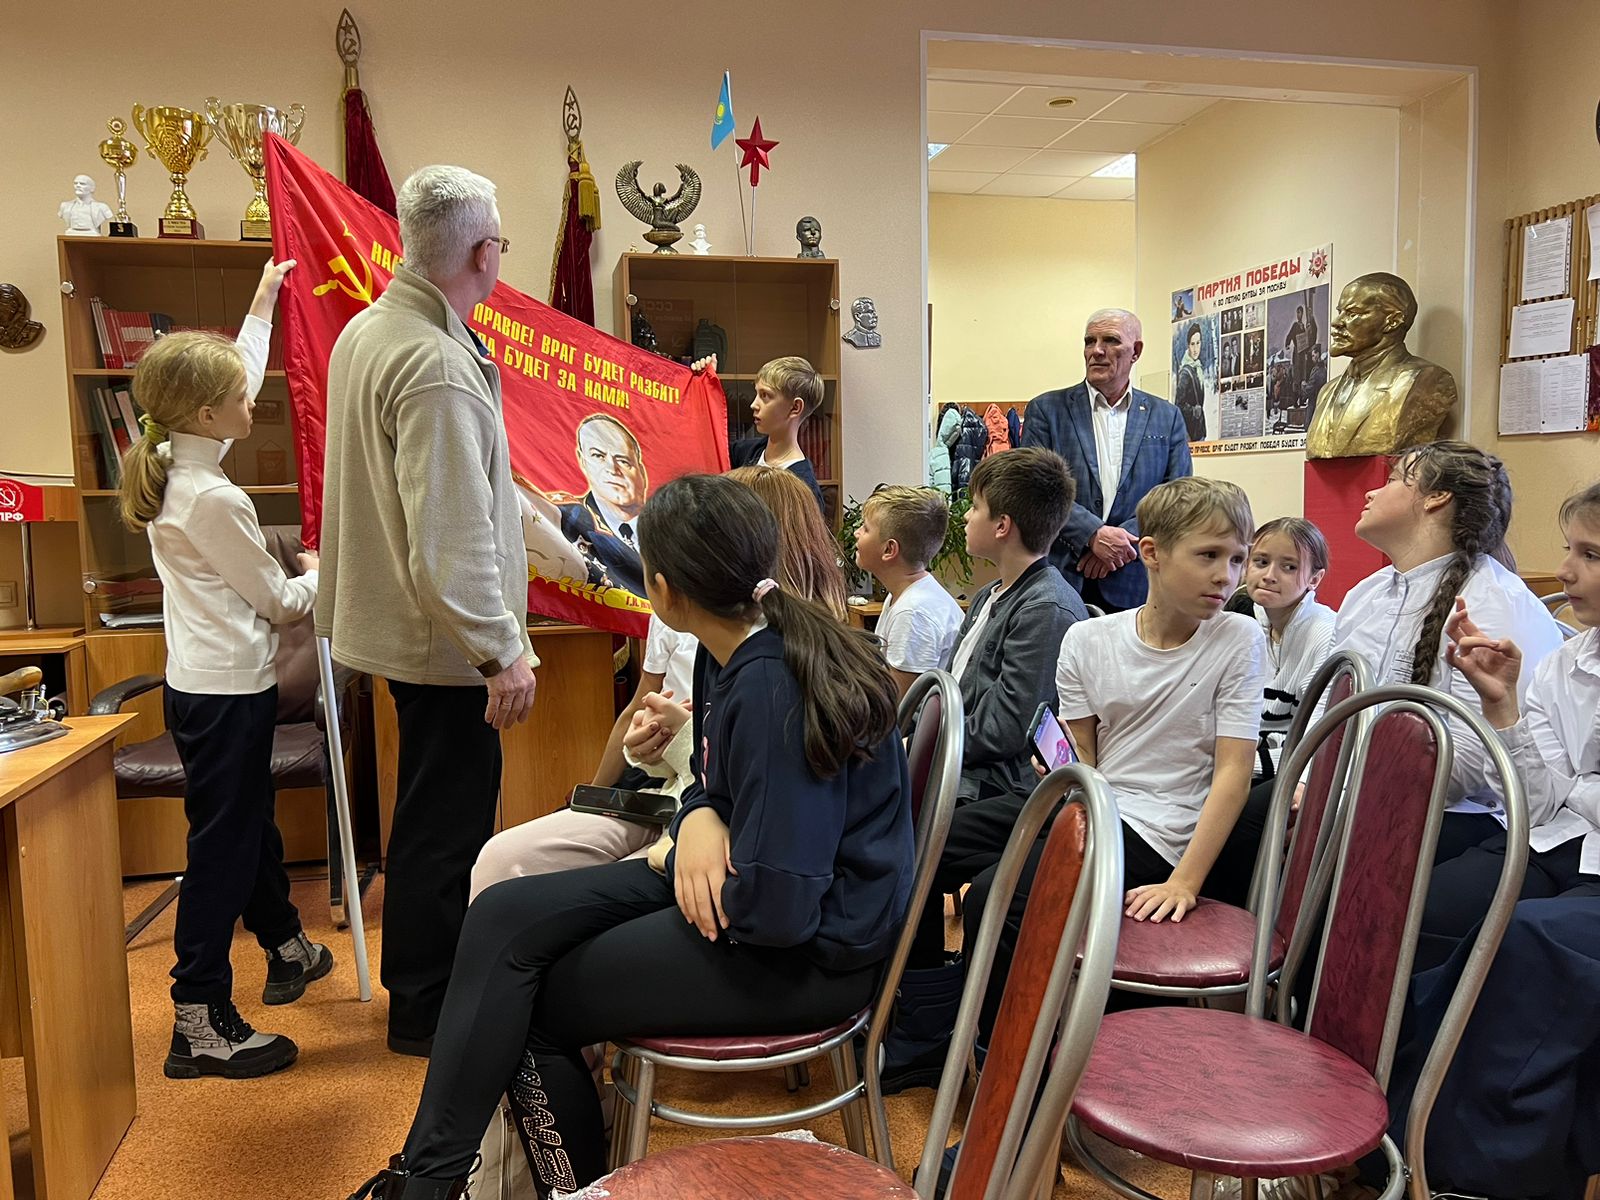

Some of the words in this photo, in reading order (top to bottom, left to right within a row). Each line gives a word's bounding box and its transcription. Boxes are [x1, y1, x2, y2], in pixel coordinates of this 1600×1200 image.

[1197, 275, 1241, 302] ПАРТИЯ
[1246, 256, 1301, 288] ПОБЕДЫ
[473, 302, 535, 348] ПРАВОЕ!
[541, 334, 577, 365] ВРАГ
[584, 352, 625, 384] БУДЕТ
[630, 371, 680, 405] РАЗБИТ!
[504, 344, 551, 381] БУДЕТ
[557, 368, 577, 392] ЗА
[584, 378, 630, 409] НАМИ!
[1281, 438, 1298, 448] БУДЕТ
